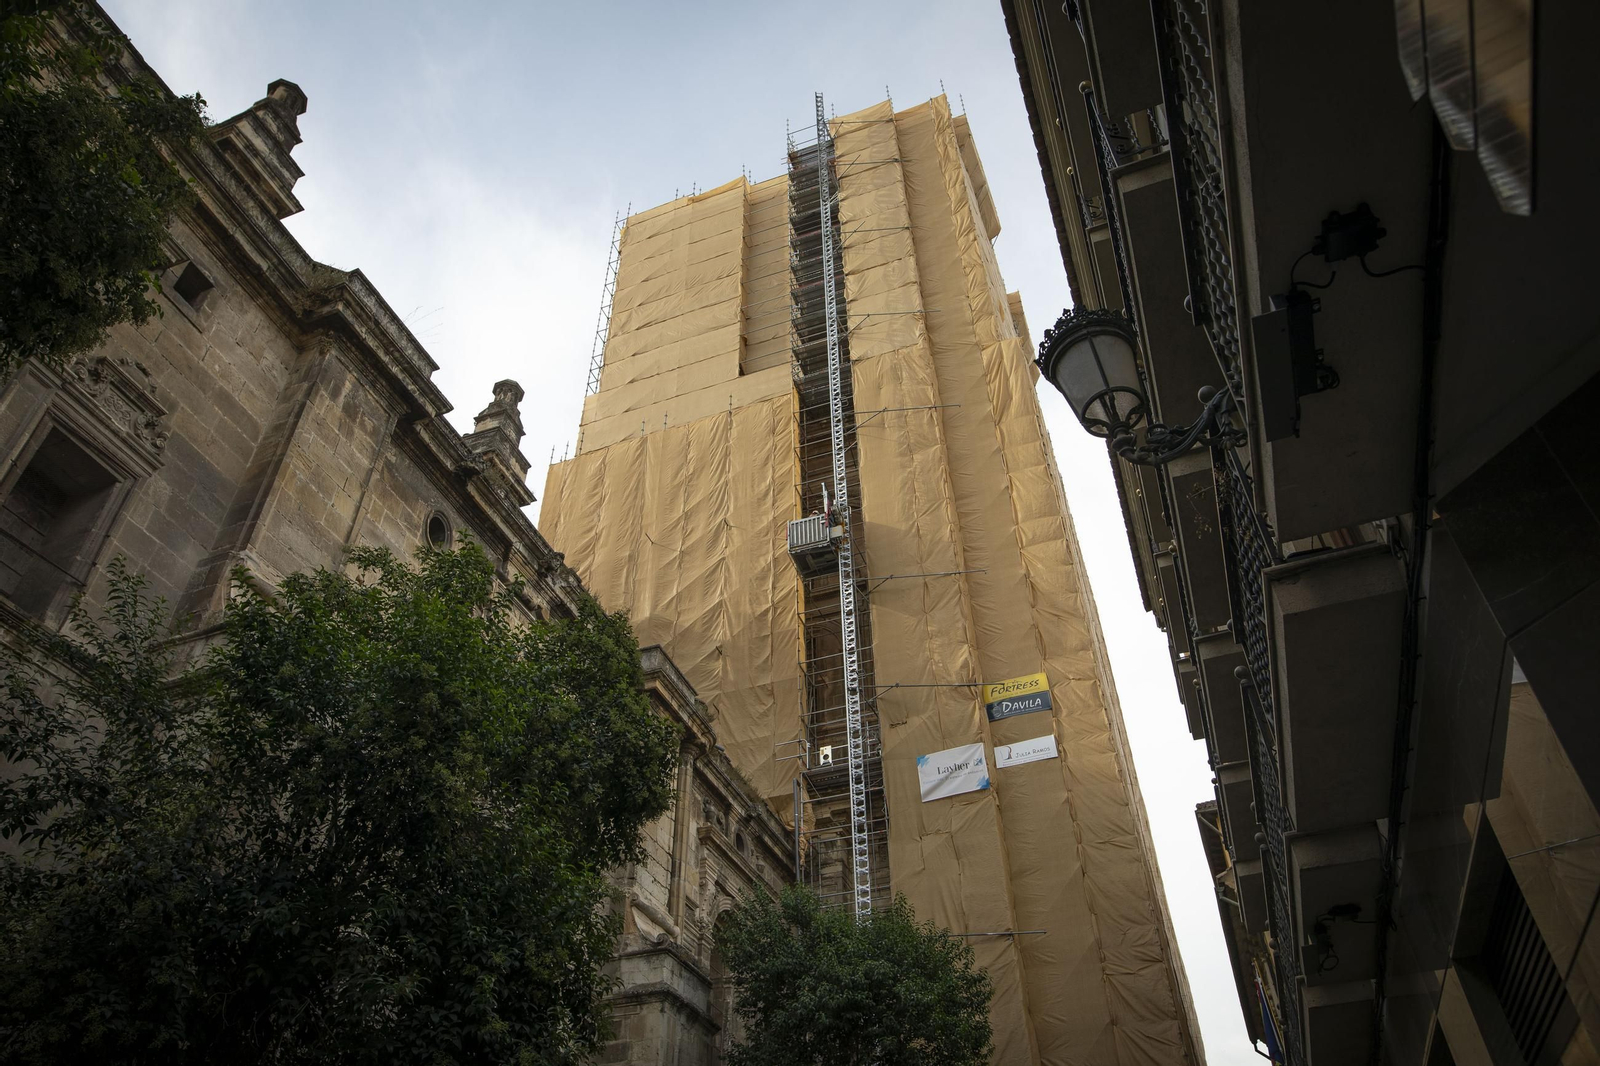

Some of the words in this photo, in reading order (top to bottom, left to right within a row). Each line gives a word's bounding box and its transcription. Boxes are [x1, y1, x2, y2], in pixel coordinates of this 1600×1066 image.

[990, 679, 1040, 698] FORTRESS
[1002, 698, 1042, 713] DAVILA
[937, 762, 970, 775] Layher
